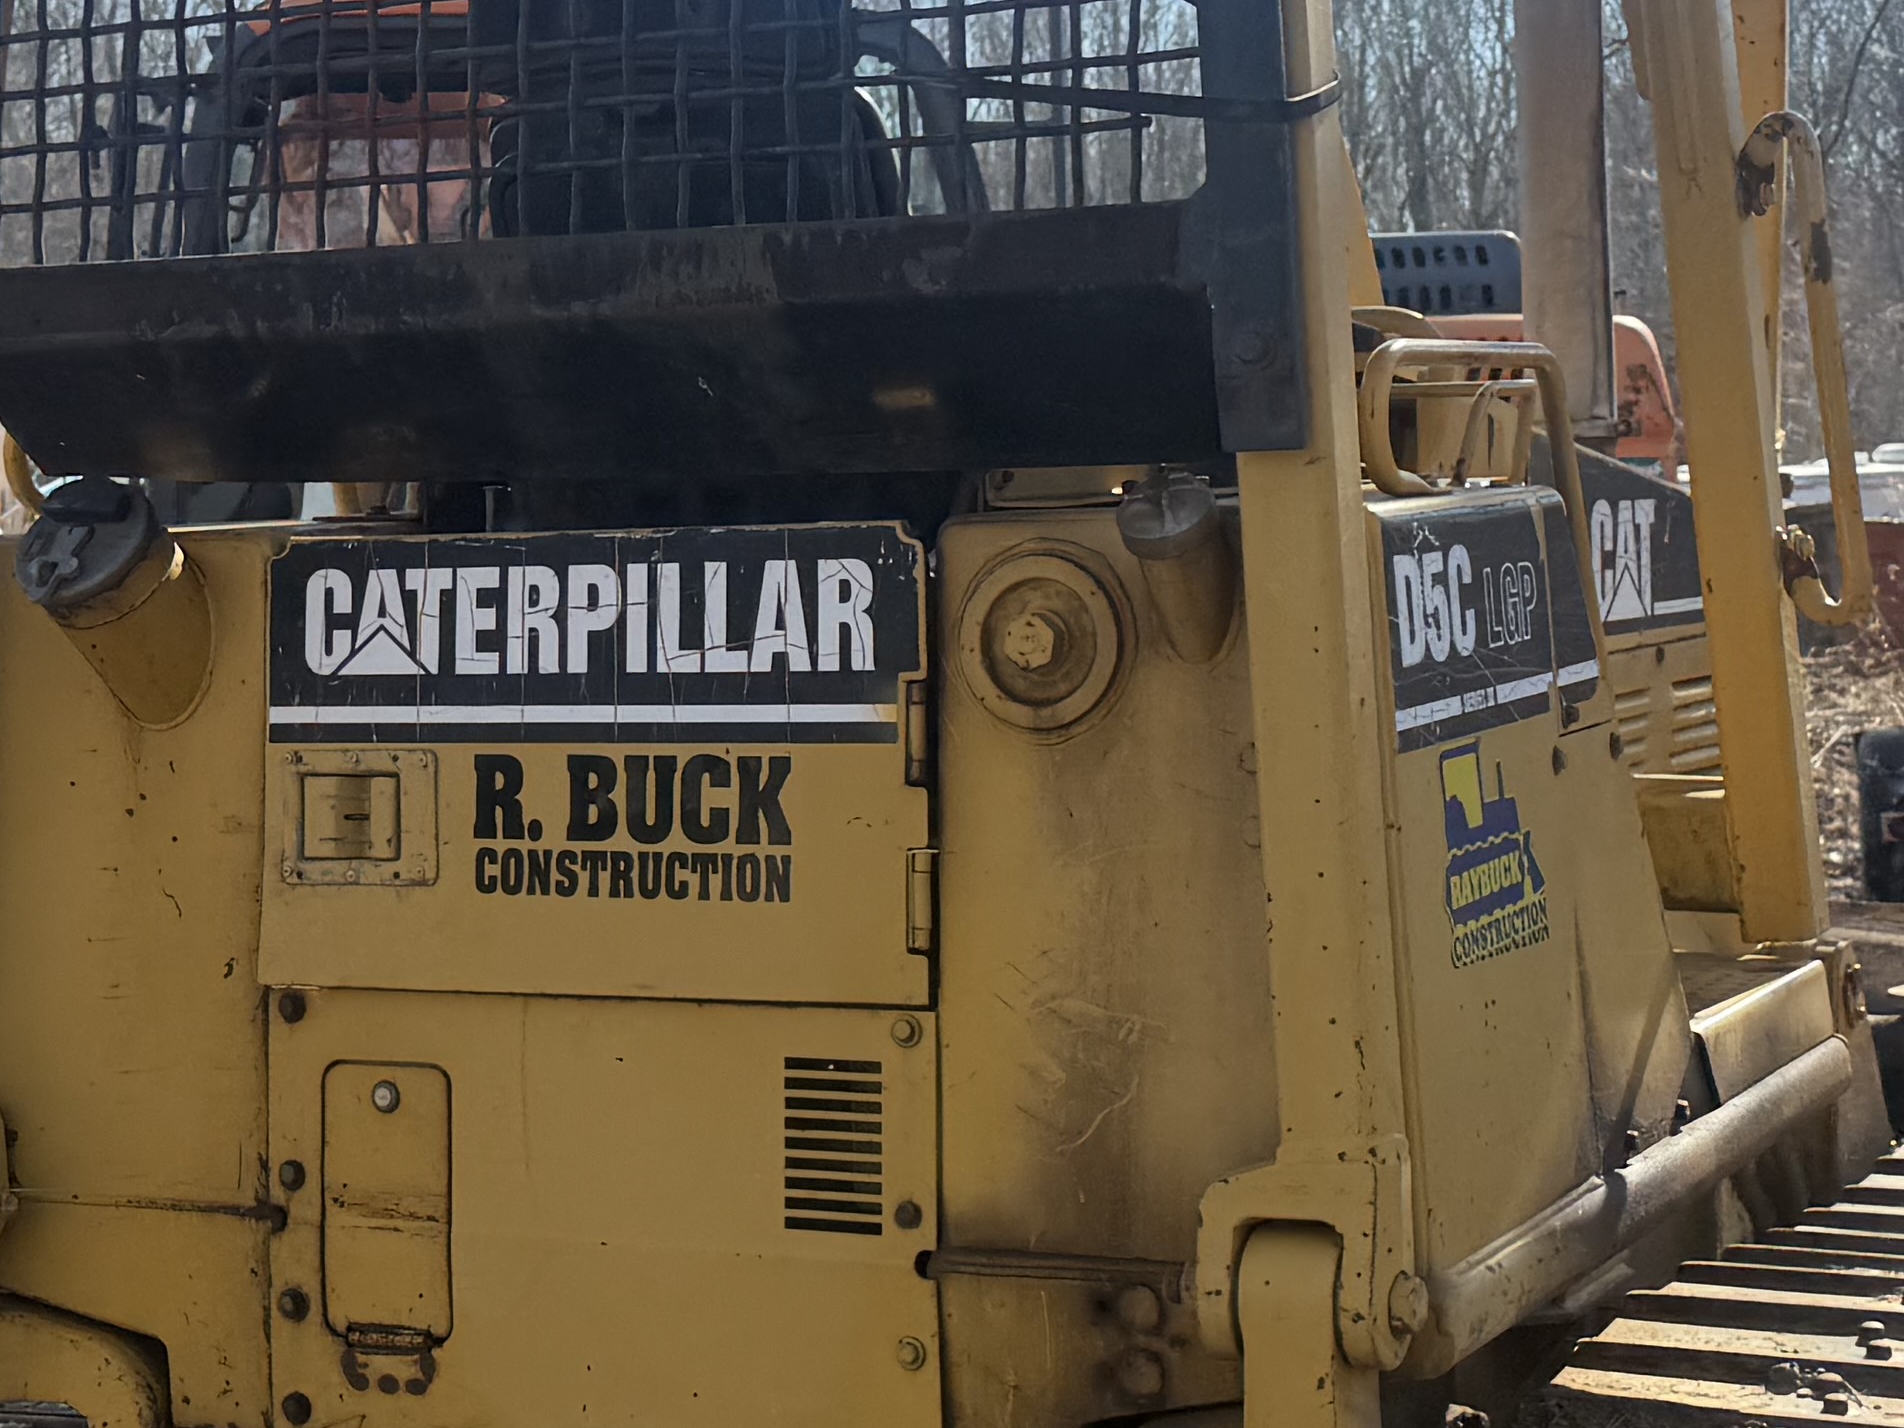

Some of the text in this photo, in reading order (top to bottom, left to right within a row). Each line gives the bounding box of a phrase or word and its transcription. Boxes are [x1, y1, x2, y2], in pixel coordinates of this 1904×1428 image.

[1392, 544, 1537, 669] D5C LGP
[1591, 498, 1656, 622] CAT
[304, 557, 876, 677] CATERPILLAR
[473, 752, 793, 846] R. BUCK
[474, 846, 792, 903] CONSTRUCTION
[1450, 850, 1522, 910] RAYBUCK
[1452, 897, 1550, 966] CONSTRUCTION
